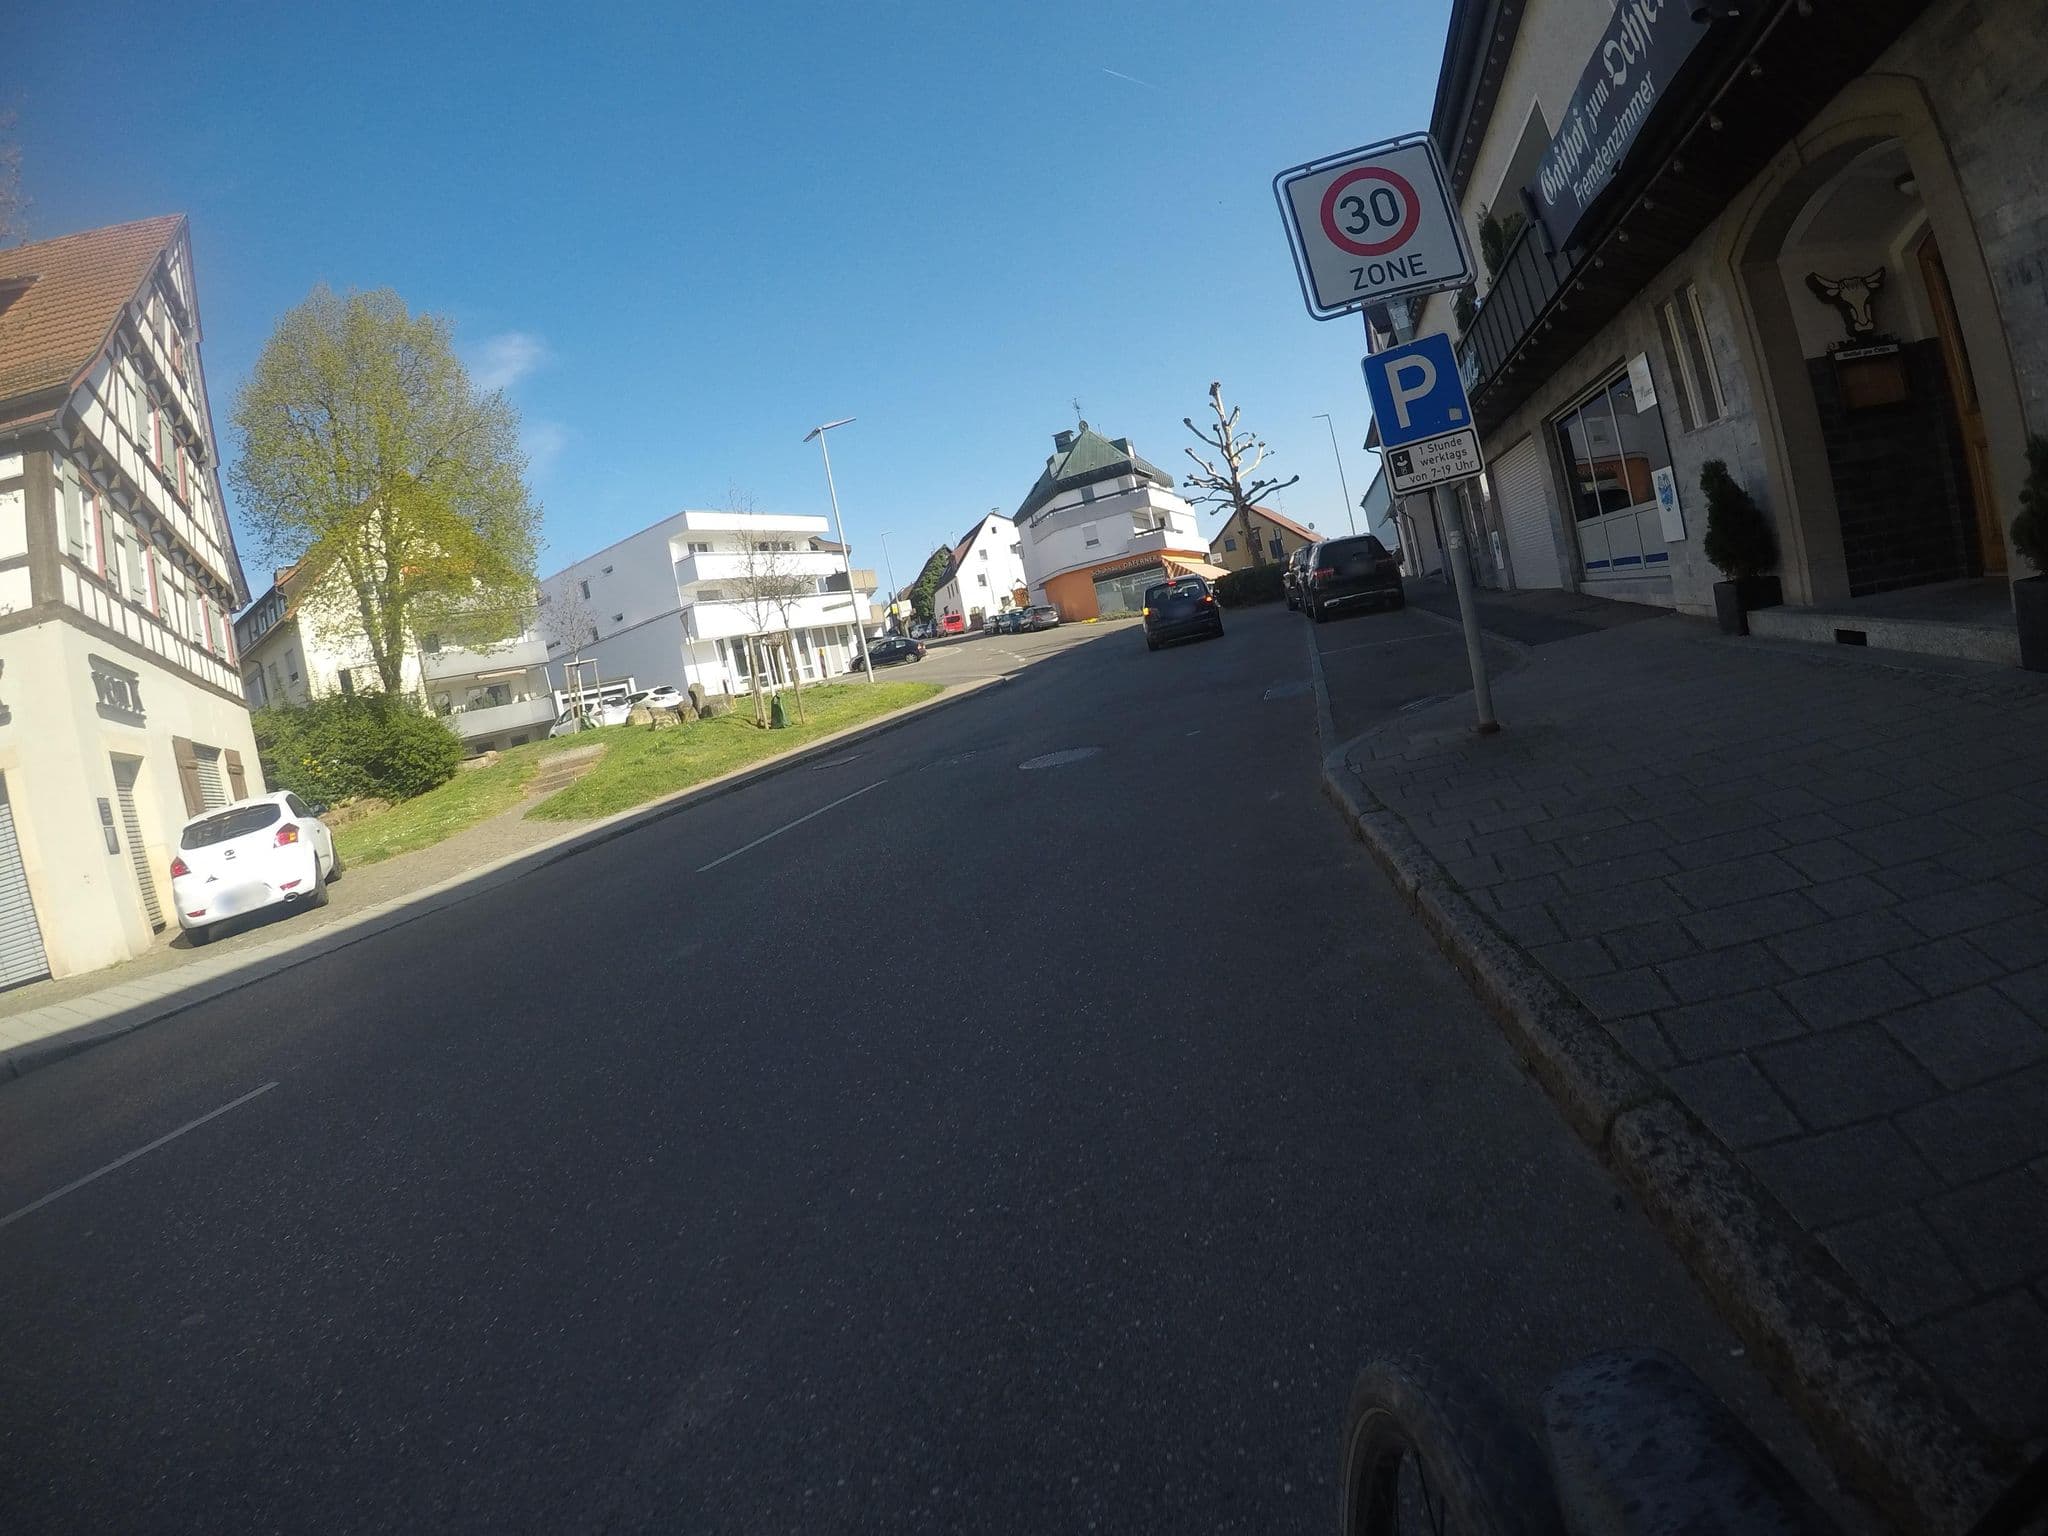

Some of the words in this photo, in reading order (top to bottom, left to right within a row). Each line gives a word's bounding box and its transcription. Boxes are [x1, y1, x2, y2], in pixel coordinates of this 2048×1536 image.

[1585, 78, 1610, 135] zum
[1573, 70, 1655, 208] Fremdenzimmer
[1339, 187, 1400, 235] 30
[1350, 253, 1427, 291] ZONE
[1384, 354, 1437, 429] P
[1418, 446, 1424, 456] 1
[1427, 437, 1463, 454] Stunde
[1420, 448, 1468, 467] werktags
[1409, 472, 1428, 483] von
[1431, 464, 1451, 478] 7-19
[1455, 460, 1475, 471] Uhr
